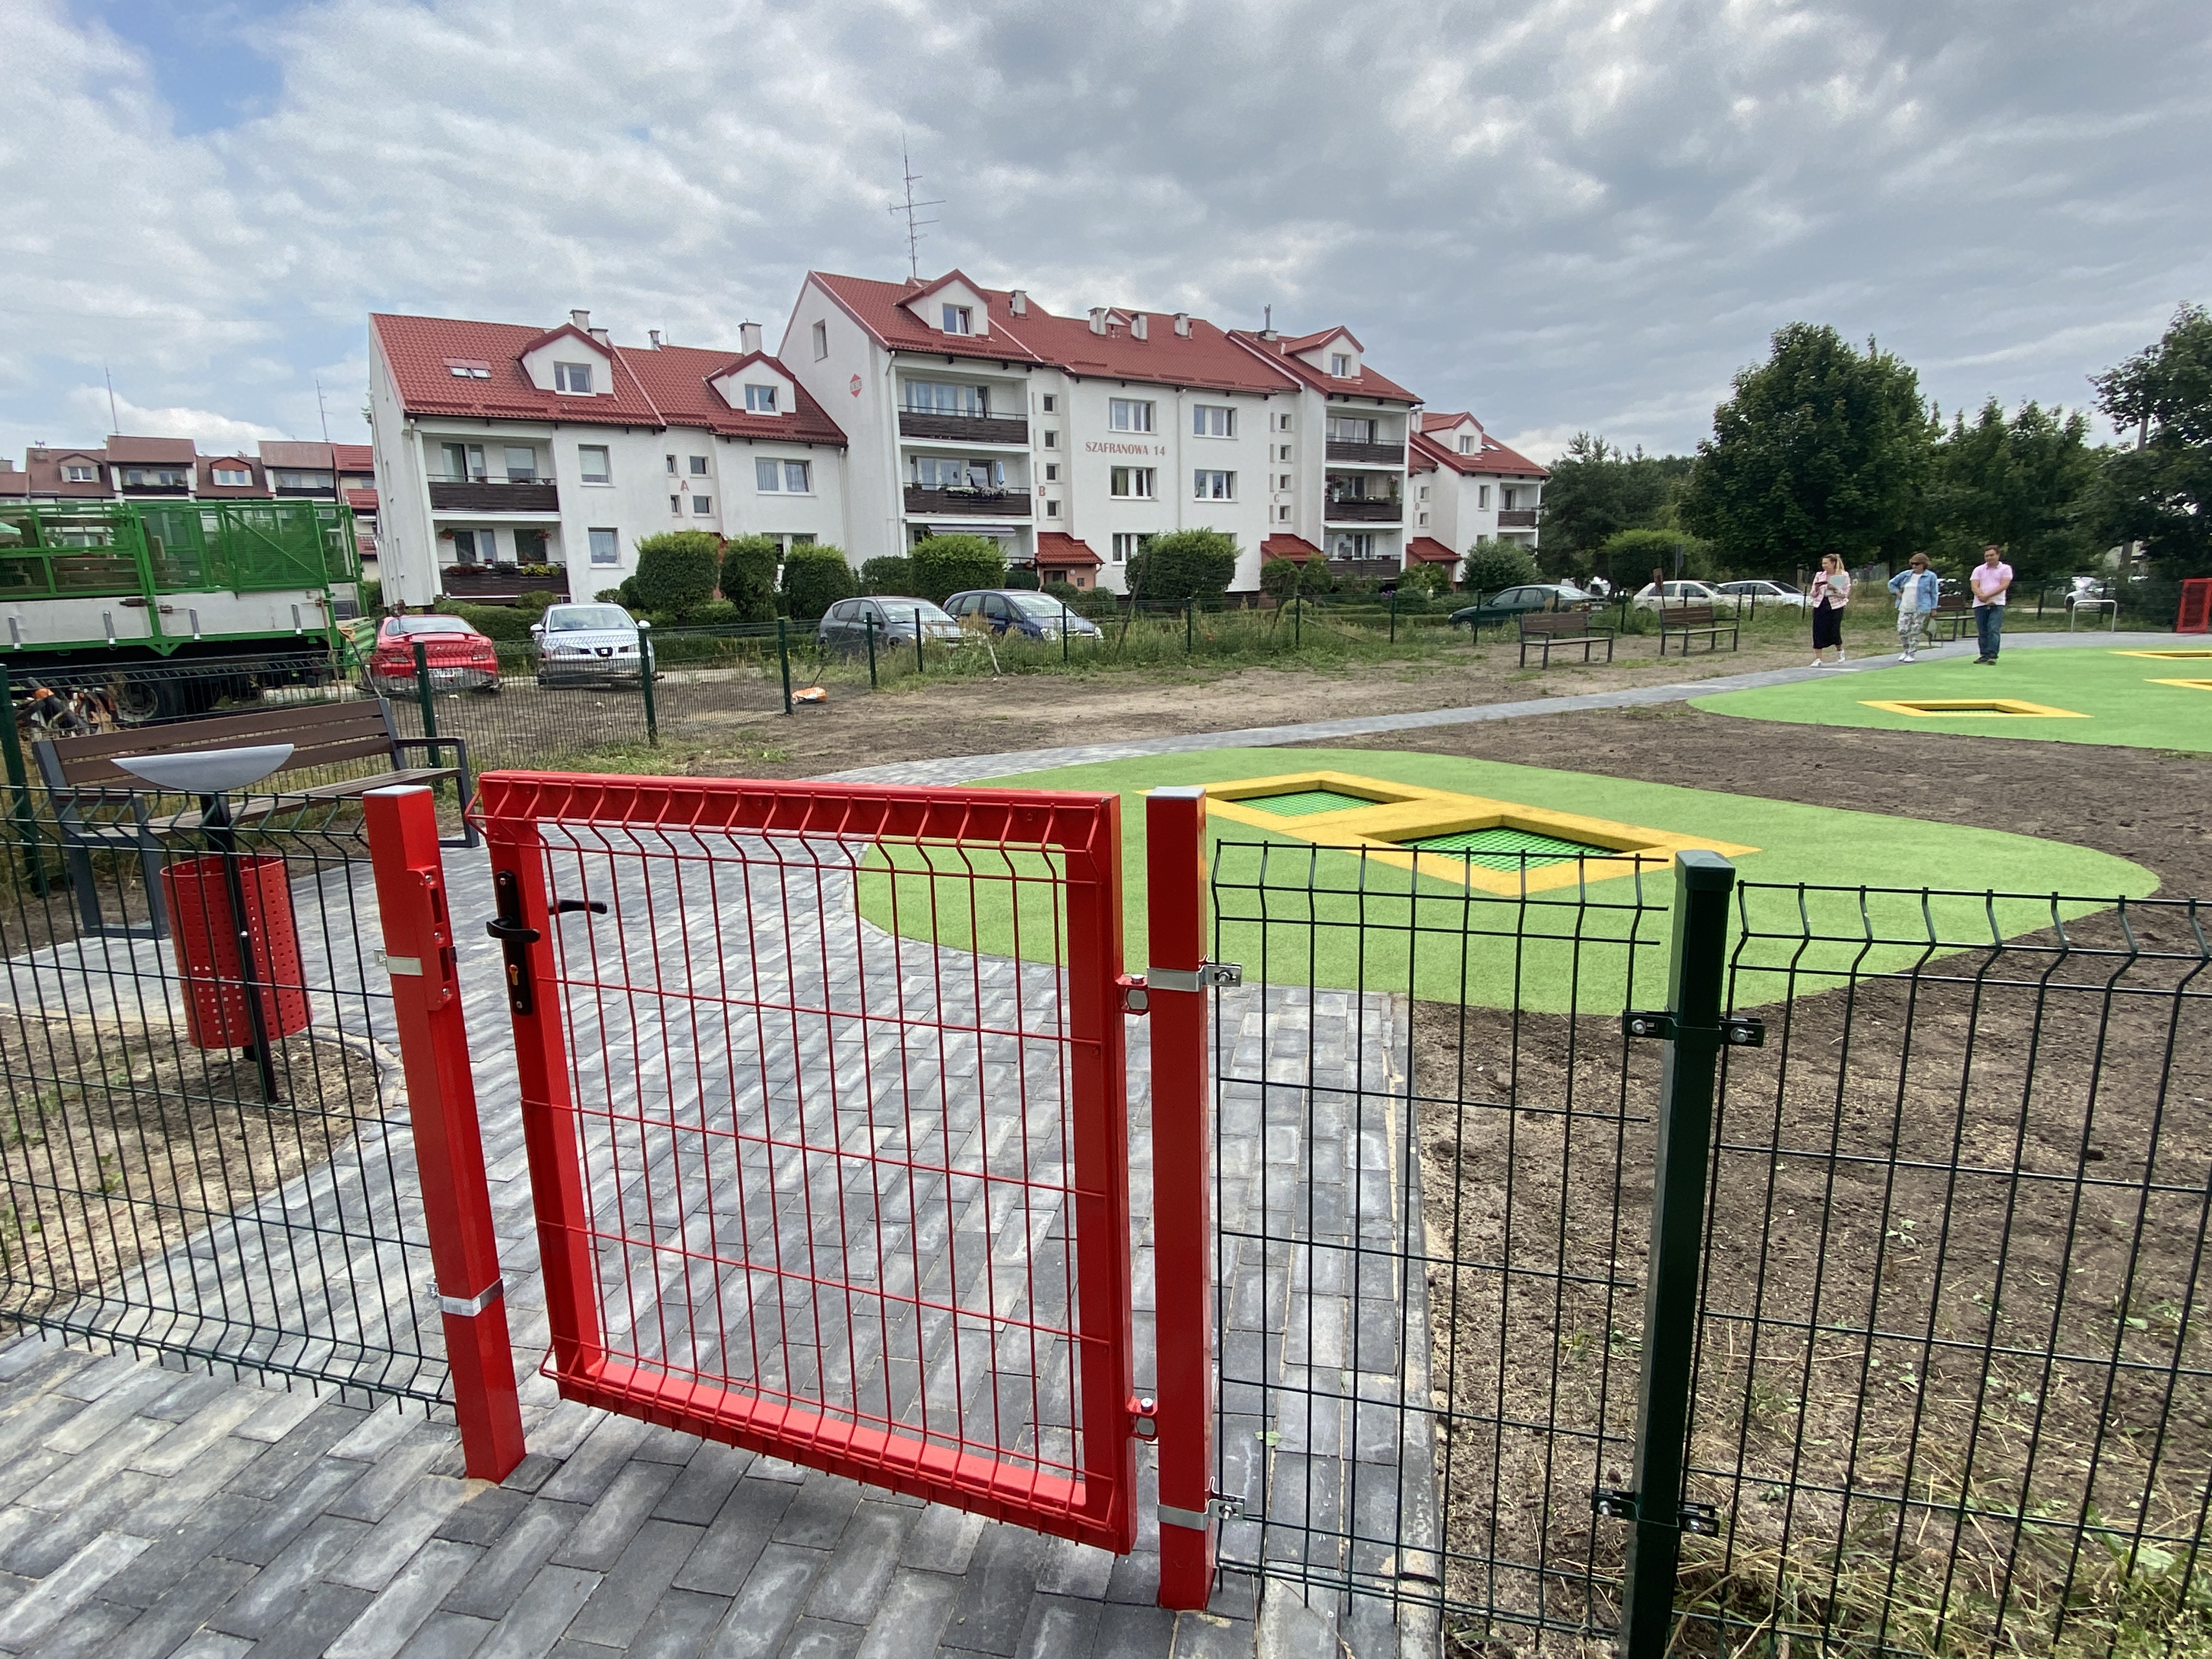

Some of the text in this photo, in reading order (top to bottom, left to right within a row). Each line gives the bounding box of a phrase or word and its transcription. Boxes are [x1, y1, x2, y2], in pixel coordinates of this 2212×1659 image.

[1085, 442, 1165, 456] SZAFRANOWA 14
[680, 480, 690, 492] A
[1039, 486, 1046, 496] B
[1274, 494, 1280, 503] C
